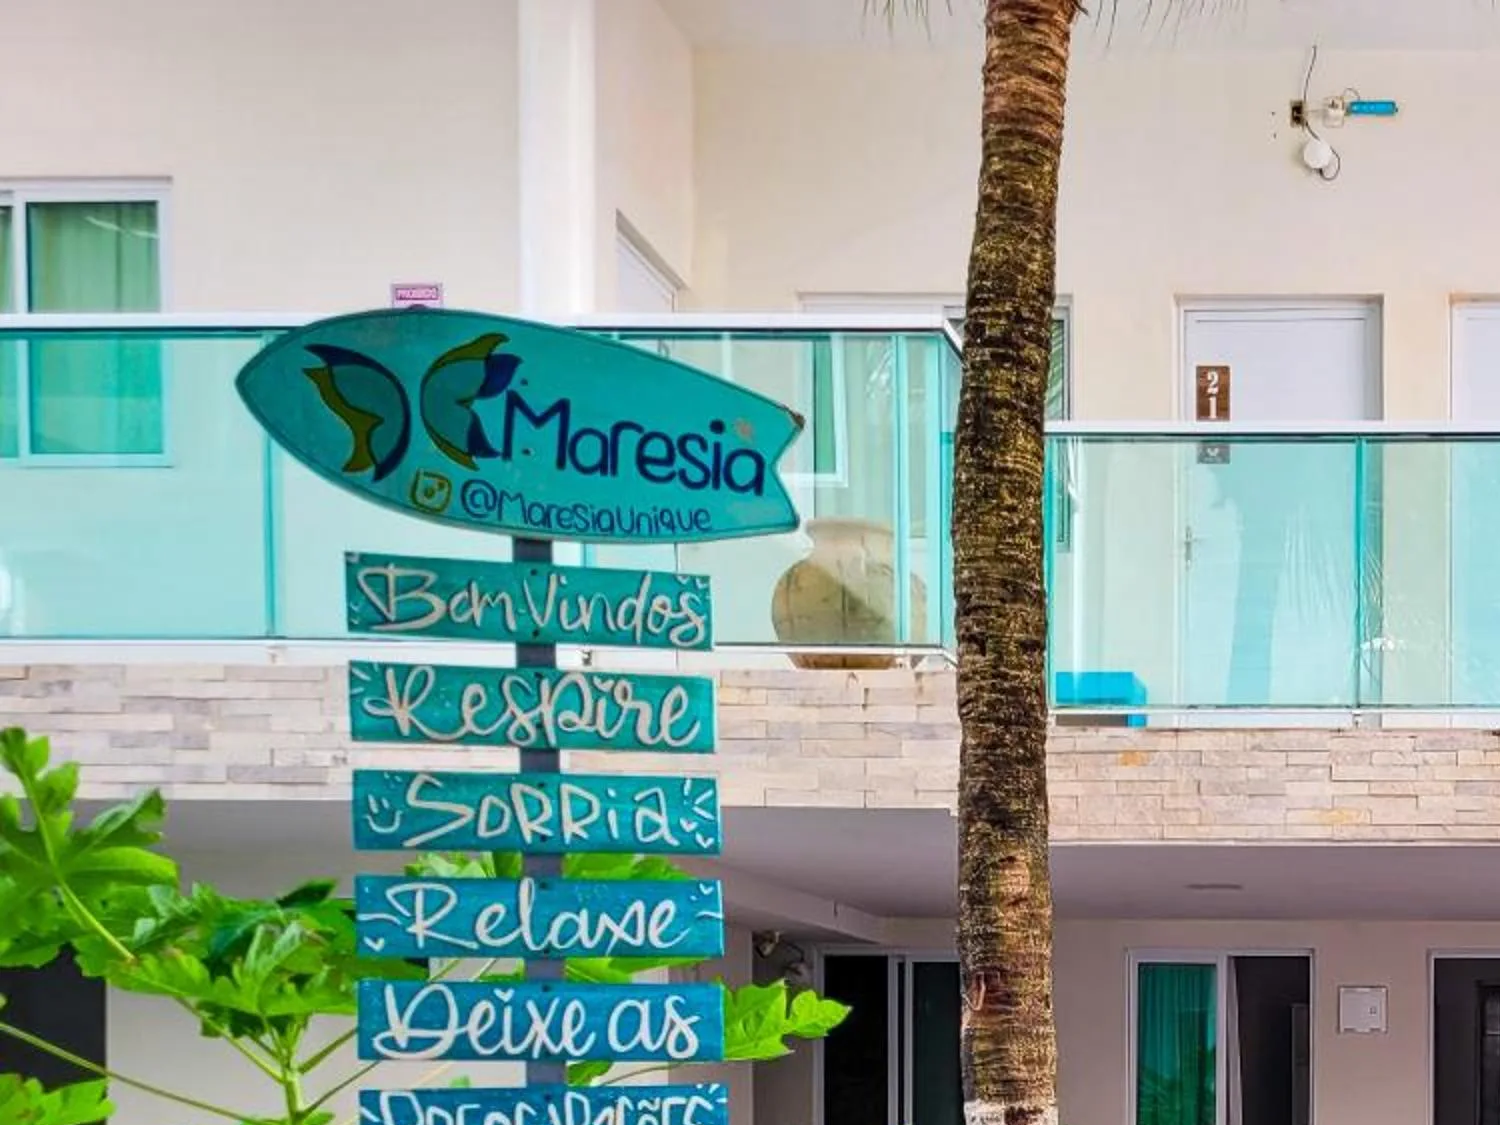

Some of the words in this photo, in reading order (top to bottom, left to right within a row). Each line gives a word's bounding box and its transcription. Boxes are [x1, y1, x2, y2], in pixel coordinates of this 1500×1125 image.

[503, 389, 767, 497] Maresia
[362, 665, 701, 747] Respire
[385, 876, 692, 955] Relaxe
[372, 983, 596, 1060] Deixe
[607, 994, 701, 1060] as
